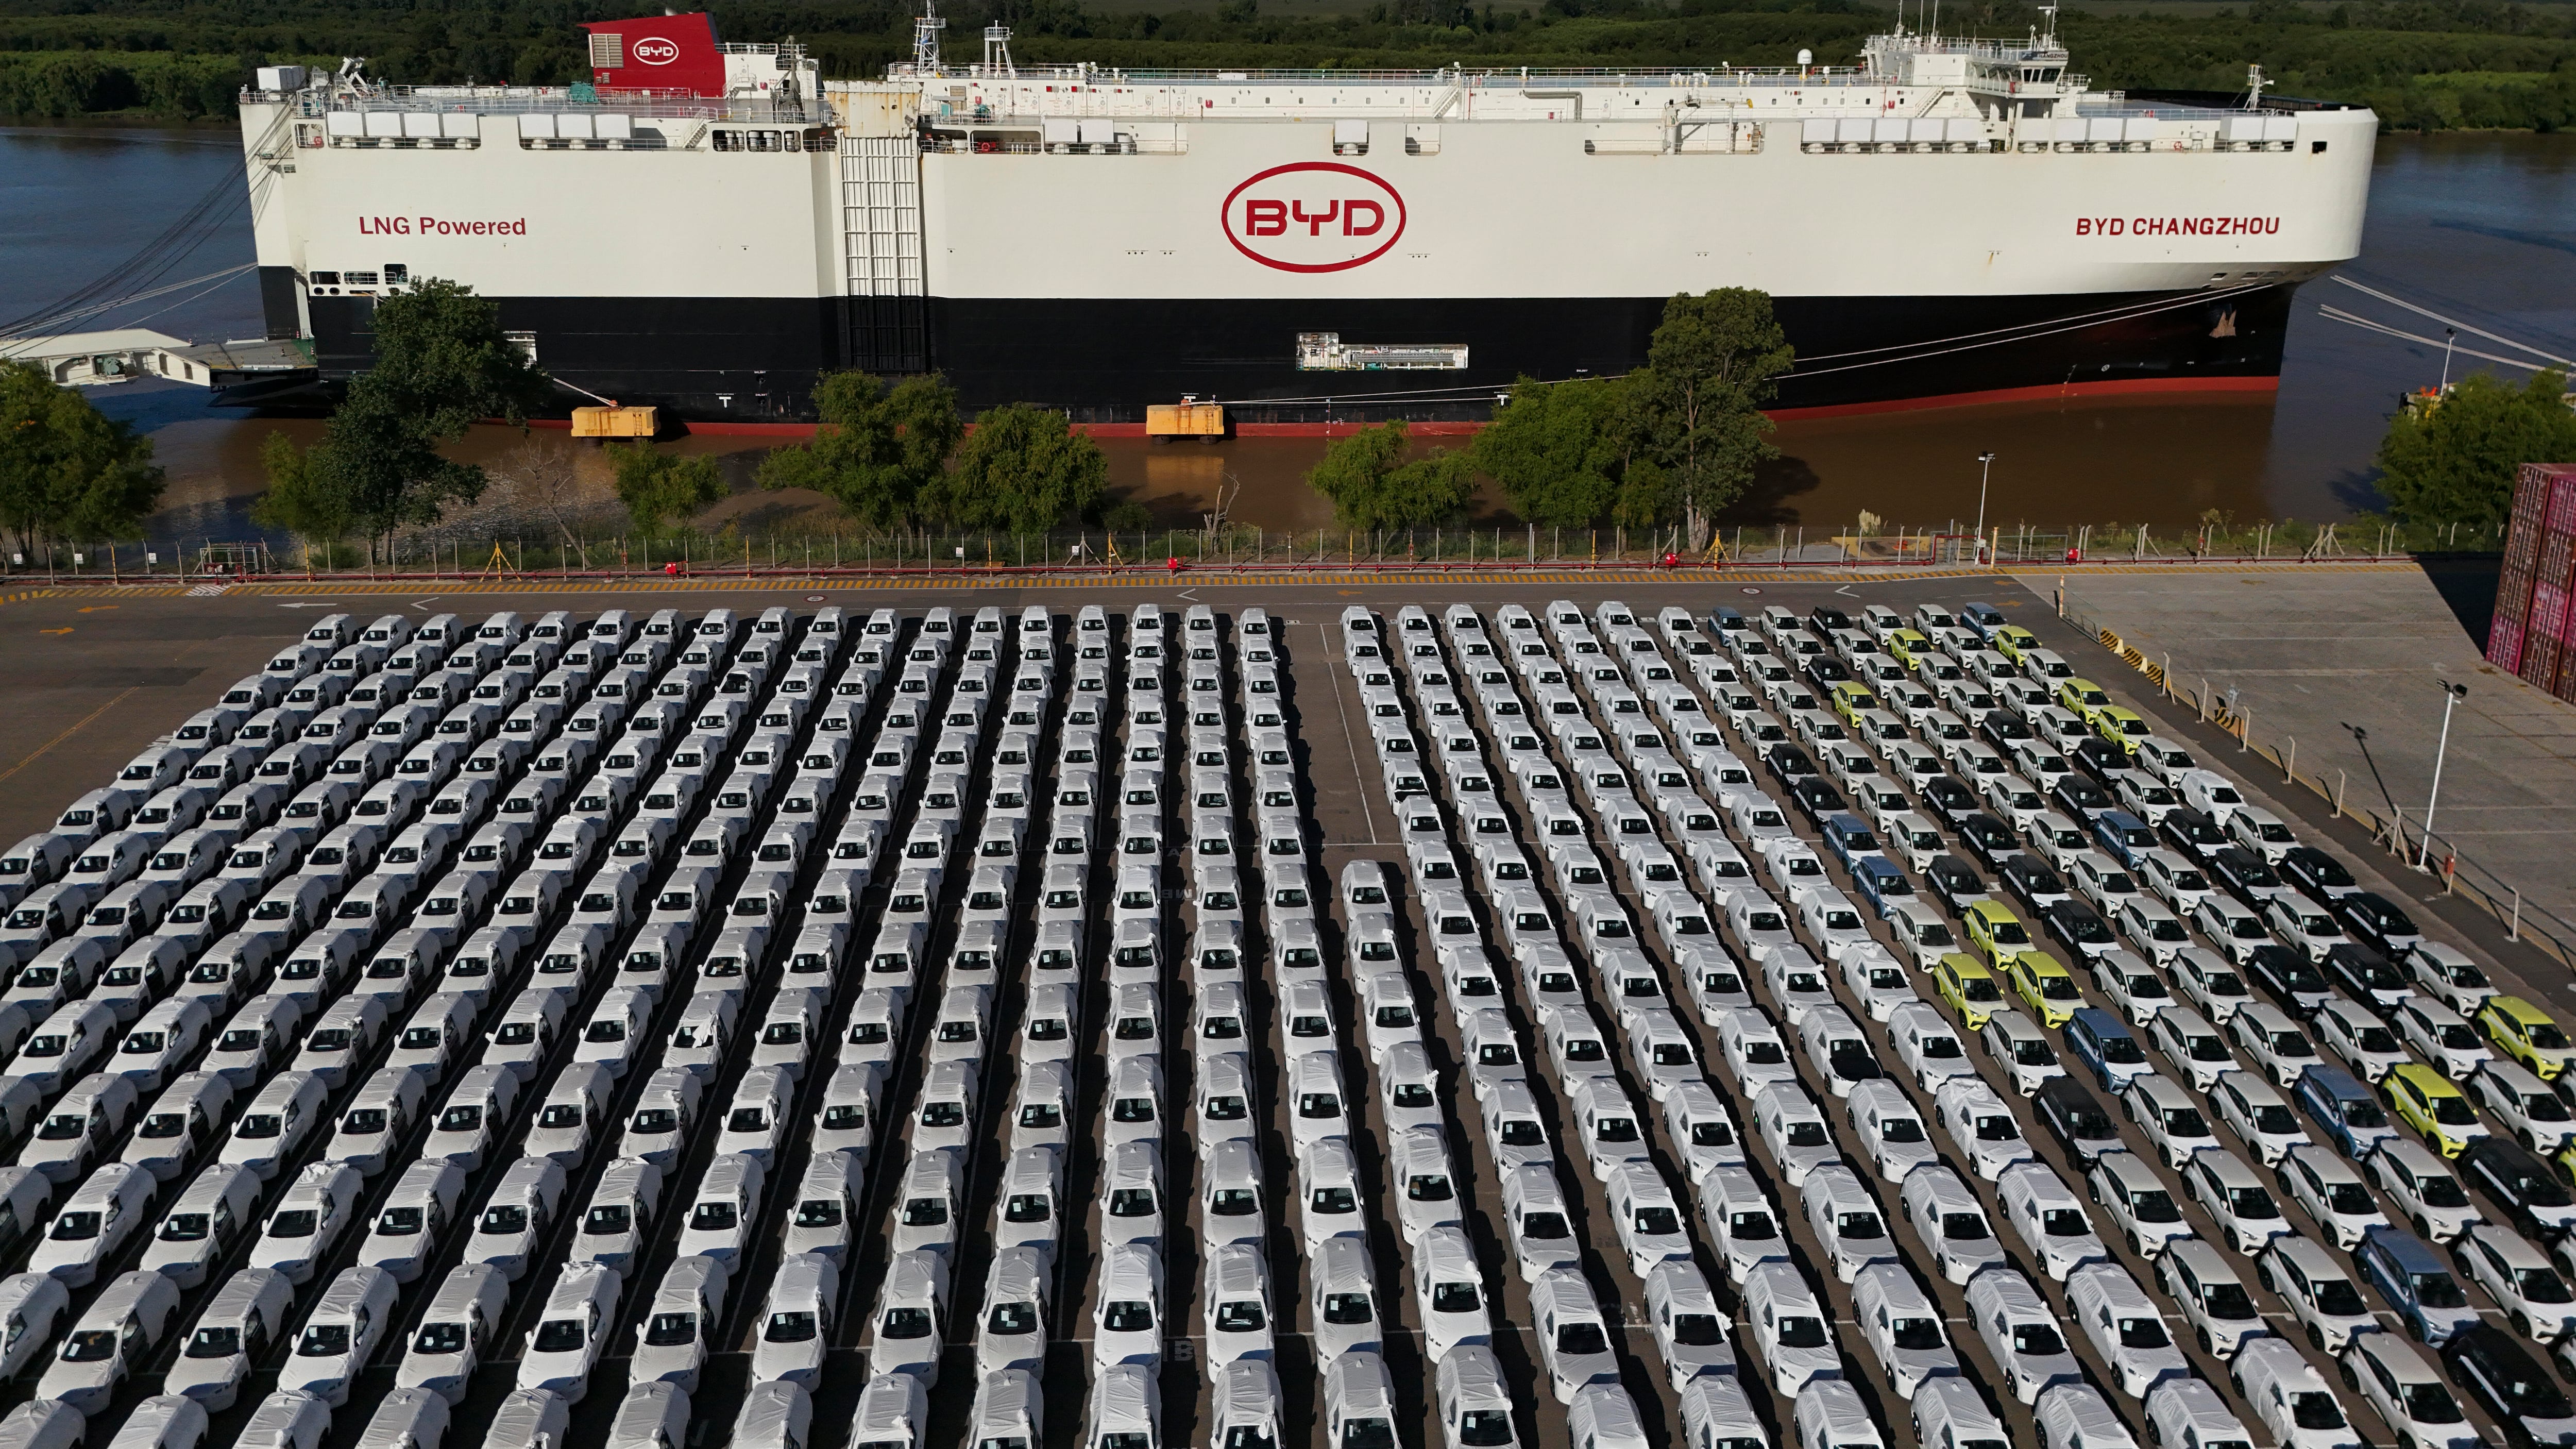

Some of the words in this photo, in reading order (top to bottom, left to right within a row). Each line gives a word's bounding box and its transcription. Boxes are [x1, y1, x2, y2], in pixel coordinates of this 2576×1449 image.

[638, 46, 674, 57] BYD
[359, 217, 410, 234] LNG
[420, 217, 526, 235] Powered
[1246, 199, 1385, 237] BYD
[2076, 218, 2124, 235] BYD
[2132, 217, 2279, 235] CHANGZHOU
